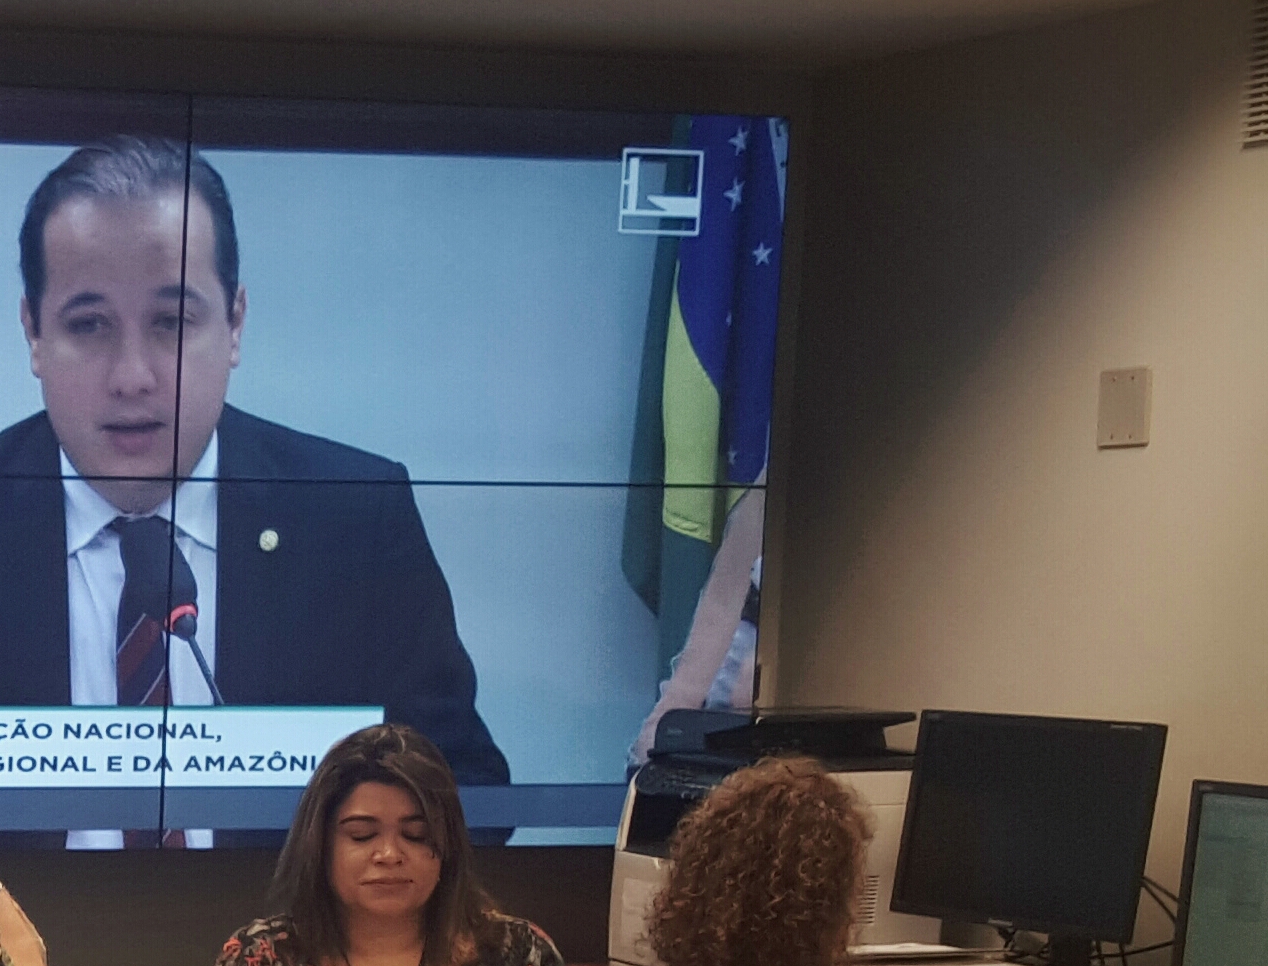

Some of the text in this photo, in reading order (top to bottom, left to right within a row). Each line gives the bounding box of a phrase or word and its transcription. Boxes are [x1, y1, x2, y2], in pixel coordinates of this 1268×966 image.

[63, 722, 222, 742] NACIONAL,
[107, 756, 122, 772] E
[133, 755, 172, 772] DA
[184, 750, 317, 772] AMAZÔNI
